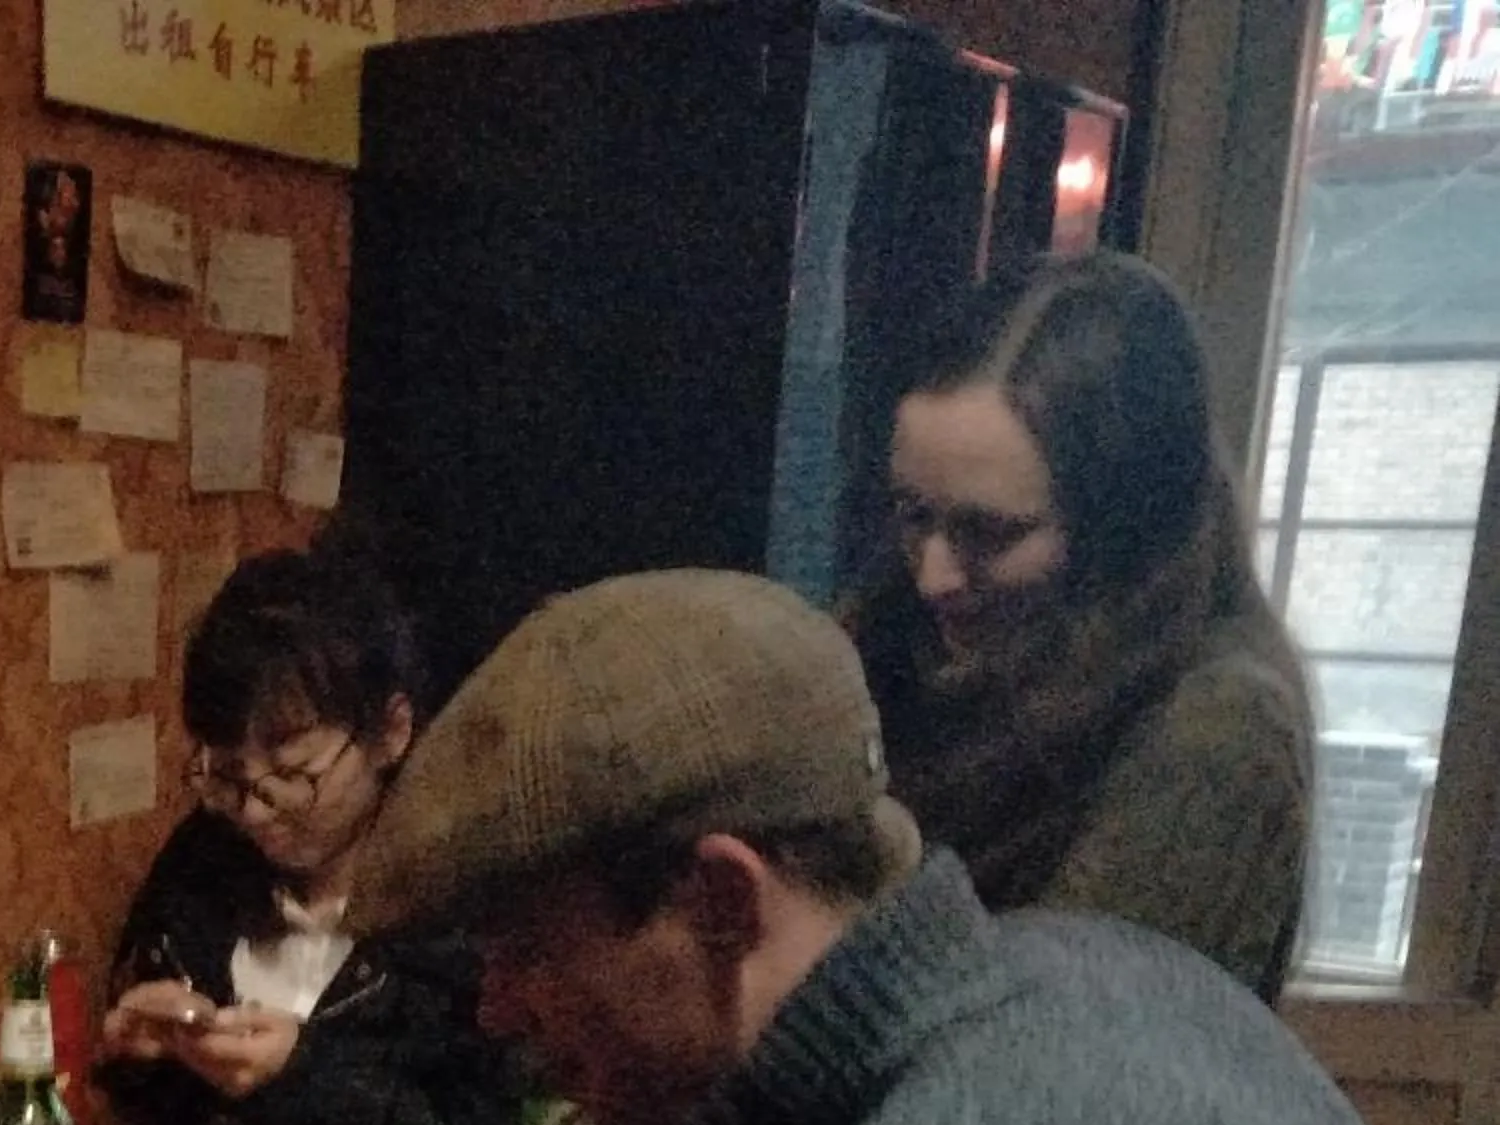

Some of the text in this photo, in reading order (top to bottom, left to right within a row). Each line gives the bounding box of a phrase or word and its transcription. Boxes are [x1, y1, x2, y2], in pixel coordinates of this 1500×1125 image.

[118, 0, 316, 103] 出租自行车
